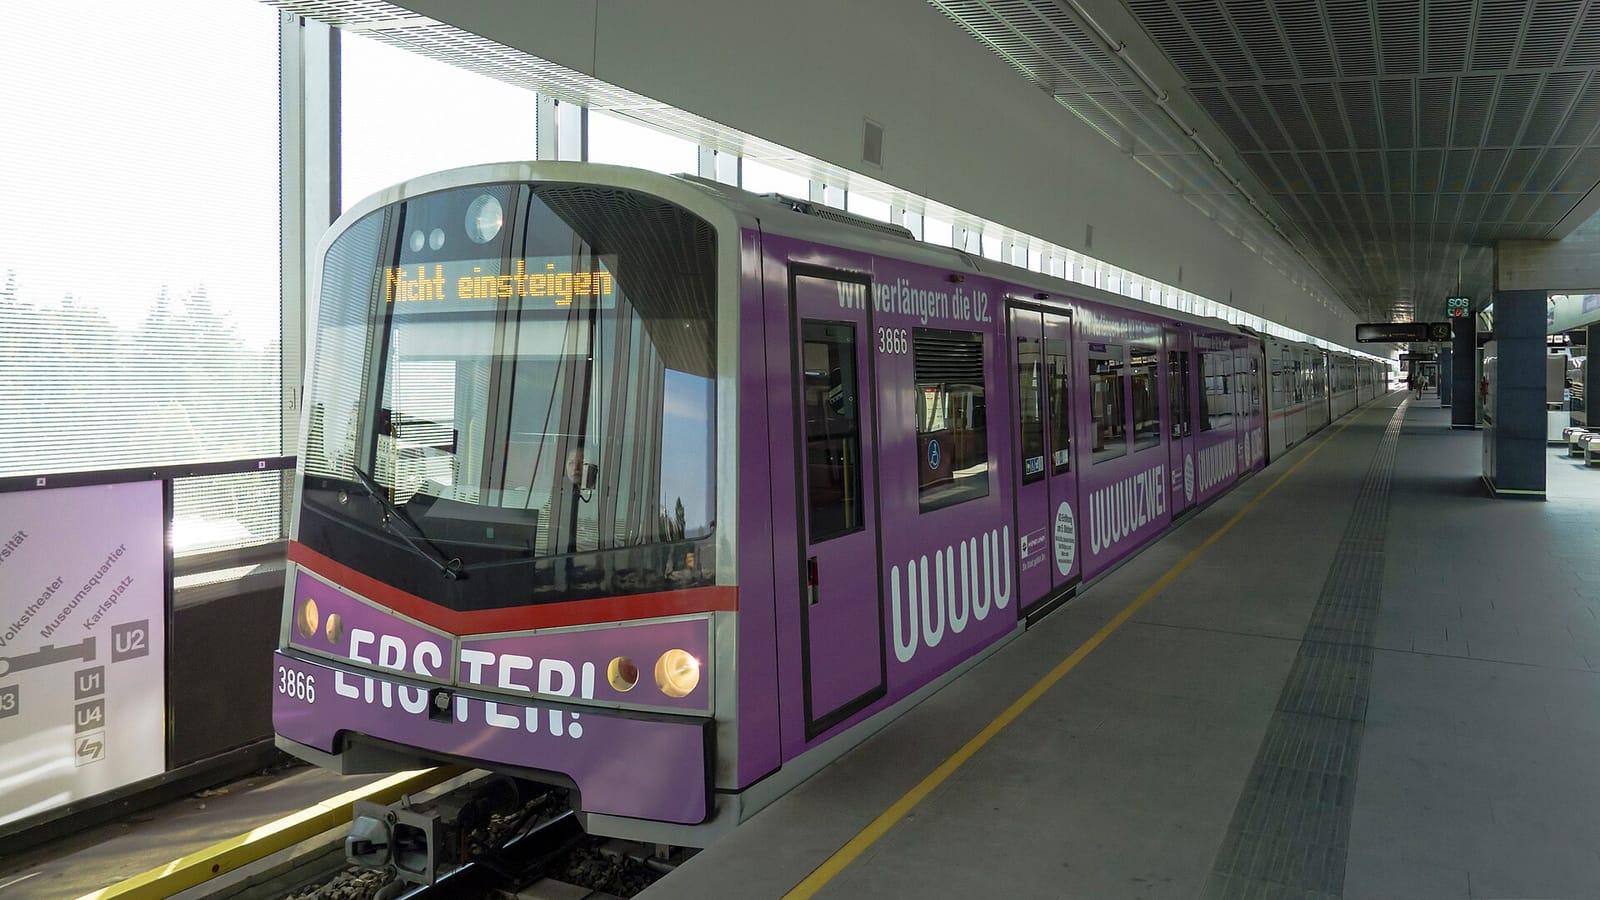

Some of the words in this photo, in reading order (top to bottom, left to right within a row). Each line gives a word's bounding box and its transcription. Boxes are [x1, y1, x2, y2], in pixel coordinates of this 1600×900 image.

[385, 264, 445, 303] Nicht
[458, 259, 612, 306] einsteigen
[872, 278, 950, 325] verlängern
[952, 287, 971, 321] die
[973, 290, 992, 323] U2.
[1448, 298, 1469, 307] SOS
[878, 327, 908, 354] 3866
[1089, 463, 1167, 556] UUUUUZWEI
[0, 576, 64, 647] Volkstheater
[40, 544, 127, 638] Museumsquartier
[83, 575, 134, 630] Karlsplatz
[891, 525, 1011, 663] UUUUU
[115, 629, 145, 653] U2
[79, 672, 101, 692] U1
[278, 666, 315, 704] 3866
[77, 706, 103, 726] U4
